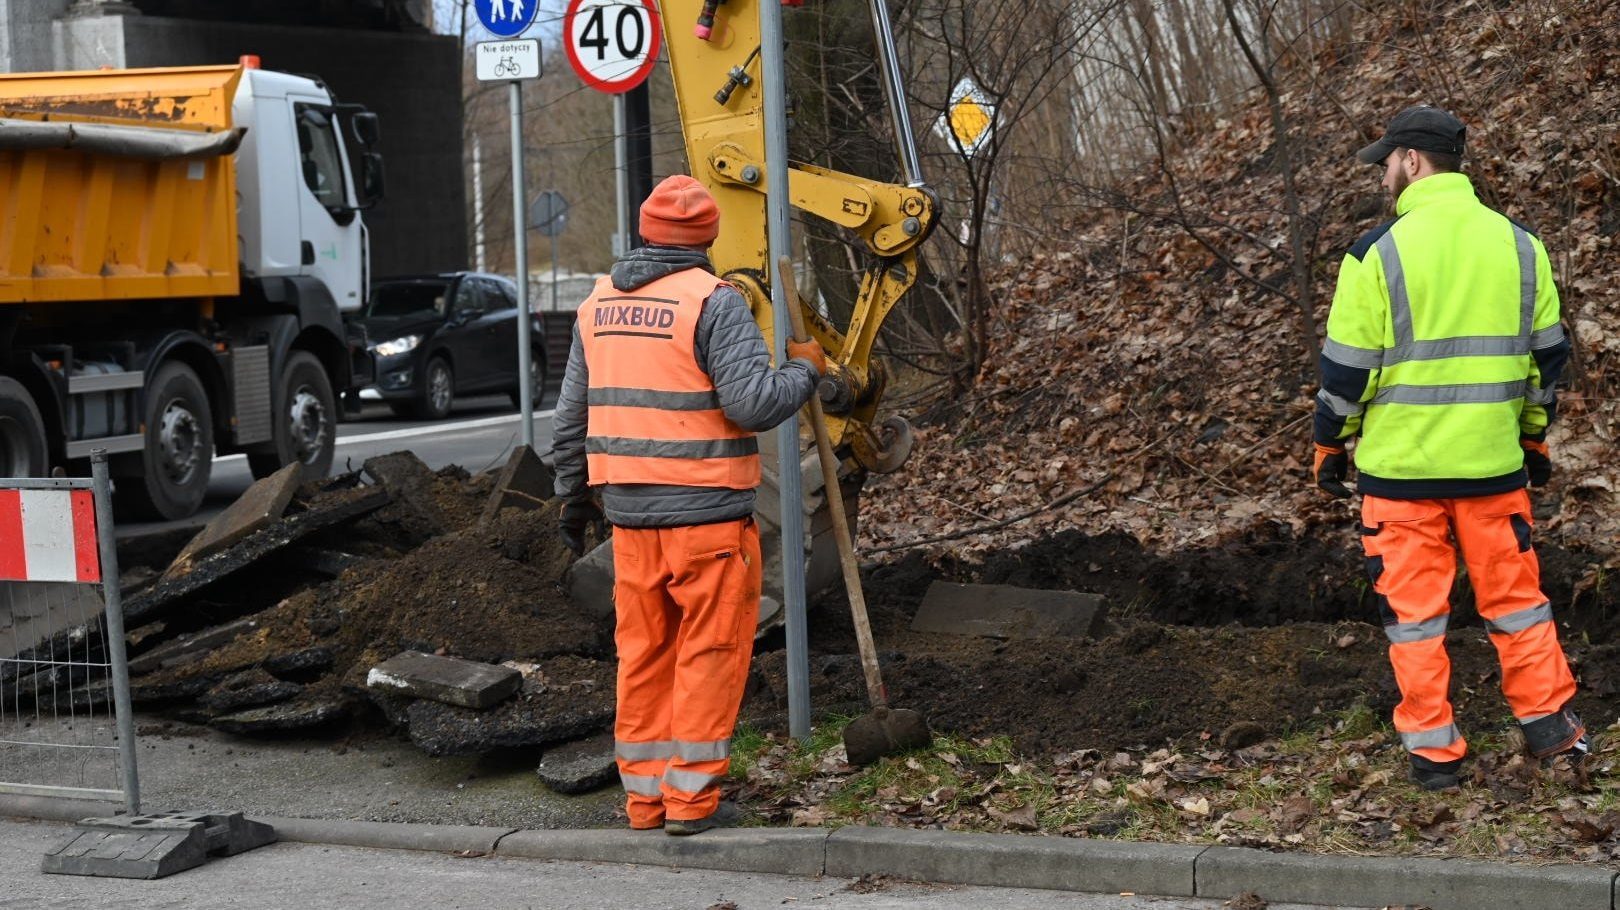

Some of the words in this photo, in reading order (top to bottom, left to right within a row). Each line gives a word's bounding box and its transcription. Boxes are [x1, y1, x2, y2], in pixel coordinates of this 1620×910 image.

[579, 6, 644, 60] 40
[483, 45, 497, 53] Nie
[500, 43, 530, 53] dotyczy
[594, 306, 674, 328] MIXBUD
